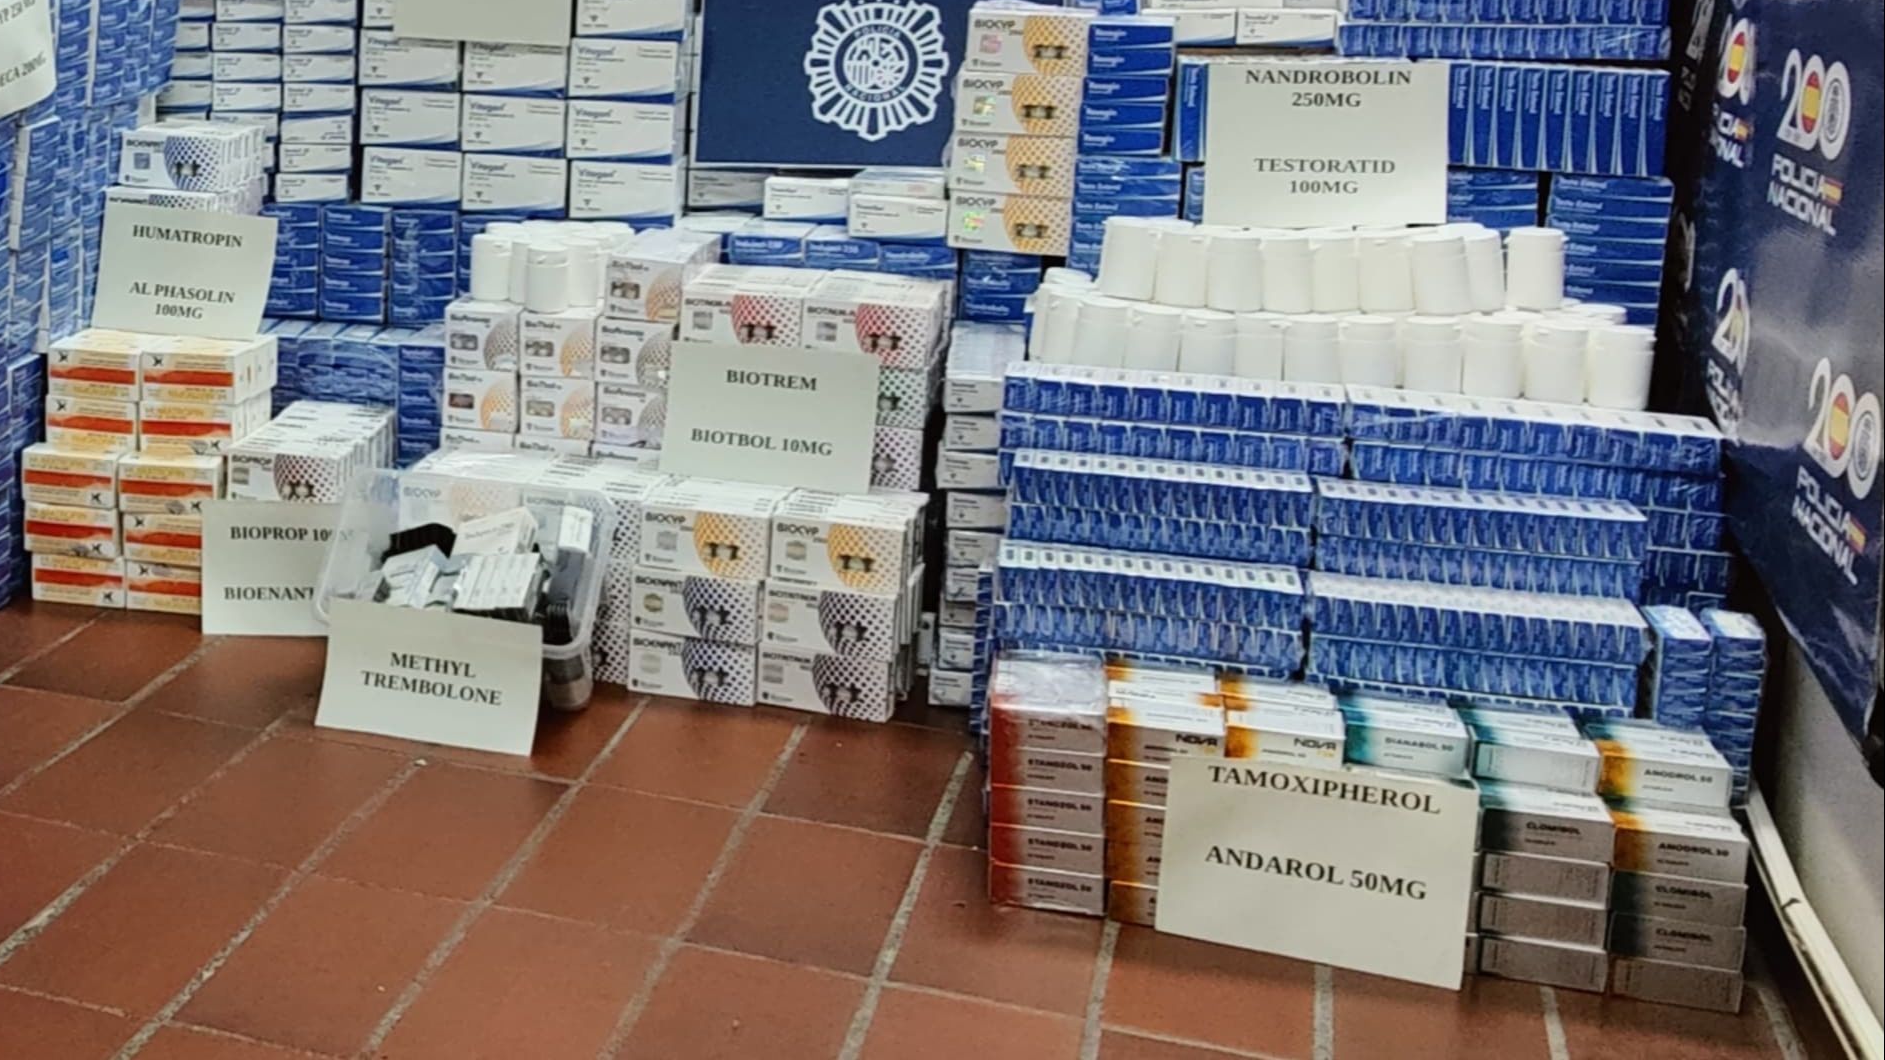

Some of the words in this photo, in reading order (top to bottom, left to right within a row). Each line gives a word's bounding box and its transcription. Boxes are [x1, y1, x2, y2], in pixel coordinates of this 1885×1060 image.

[1245, 69, 1412, 85] NANDROBOLIN
[1292, 92, 1362, 108] 250MG
[1776, 48, 1852, 161] 200
[1254, 157, 1396, 174] TESTORATID
[1289, 180, 1359, 195] 100MG
[1766, 180, 1837, 237] NACIONAL
[132, 224, 243, 248] HUMATROPIN
[155, 303, 203, 320] 100MG
[725, 368, 818, 391] BIOTREM
[690, 427, 777, 451] BIOTBOL
[781, 438, 833, 457] 10MG
[1803, 357, 1882, 500] 200
[230, 525, 309, 541] BIOPROP
[1791, 496, 1858, 586] NACIONAL
[389, 651, 477, 679] METHYL
[361, 670, 503, 707] TREMBOLONE
[1208, 764, 1442, 815] TAMOXIPHEROL
[1203, 843, 1346, 889] ANDAROL
[1348, 868, 1429, 901] 50MG
